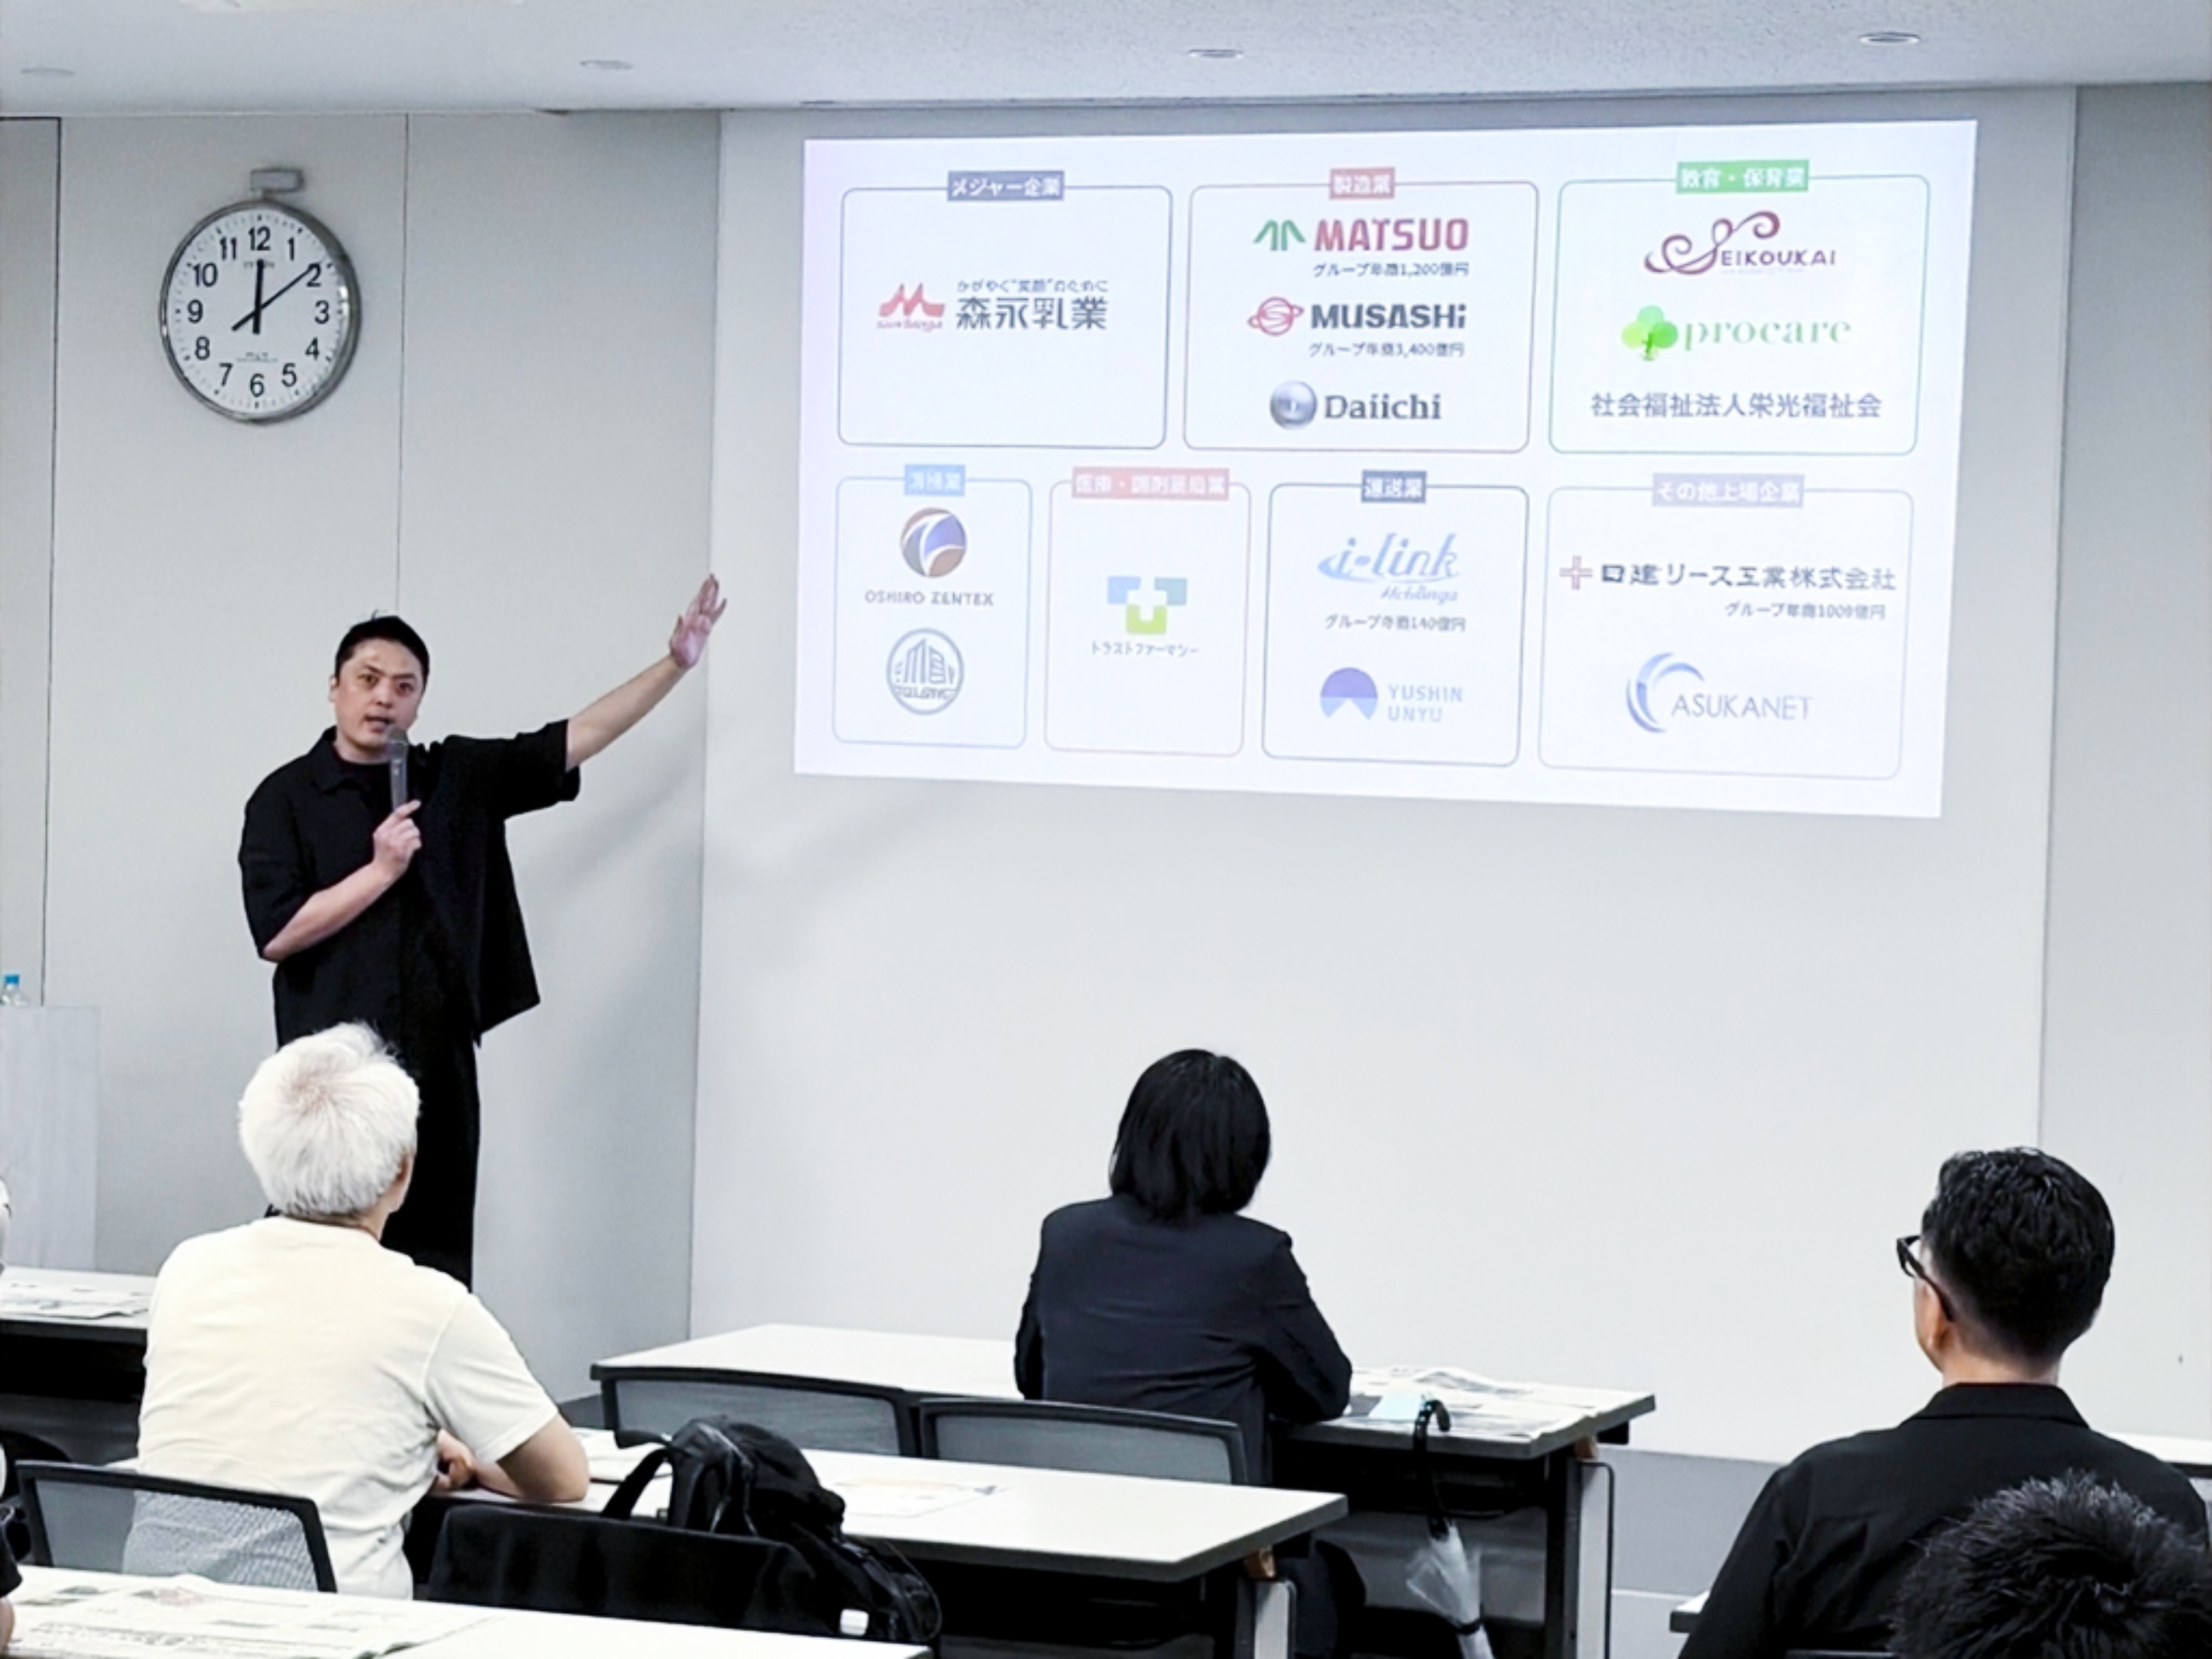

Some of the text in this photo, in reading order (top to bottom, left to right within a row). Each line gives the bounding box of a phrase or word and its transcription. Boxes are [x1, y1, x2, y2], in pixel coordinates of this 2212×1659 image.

[952, 177, 1062, 197] メジャー企業
[249, 226, 270, 251] 12
[1314, 218, 1468, 251] MATSUO
[220, 236, 237, 261] 11
[287, 237, 295, 261] 1
[193, 262, 218, 287] 10
[306, 263, 321, 287] 2
[188, 300, 203, 324] 9
[315, 300, 330, 324] 3
[956, 296, 1108, 330] 森永乳業
[195, 336, 210, 360] 8
[305, 337, 320, 360] 4
[1684, 322, 1850, 352] procare
[219, 363, 233, 387] 7
[250, 373, 264, 398] 6
[281, 363, 297, 387] 5
[1325, 393, 1441, 419] Daiichi
[1592, 392, 1881, 418] 社会福祉法人栄光福祉会
[865, 590, 993, 606] OSHIRO ZENTEX
[1388, 685, 1463, 702] YUSHIN
[1388, 706, 1443, 723] UNYU
[1672, 693, 1813, 720] ASUKANET
